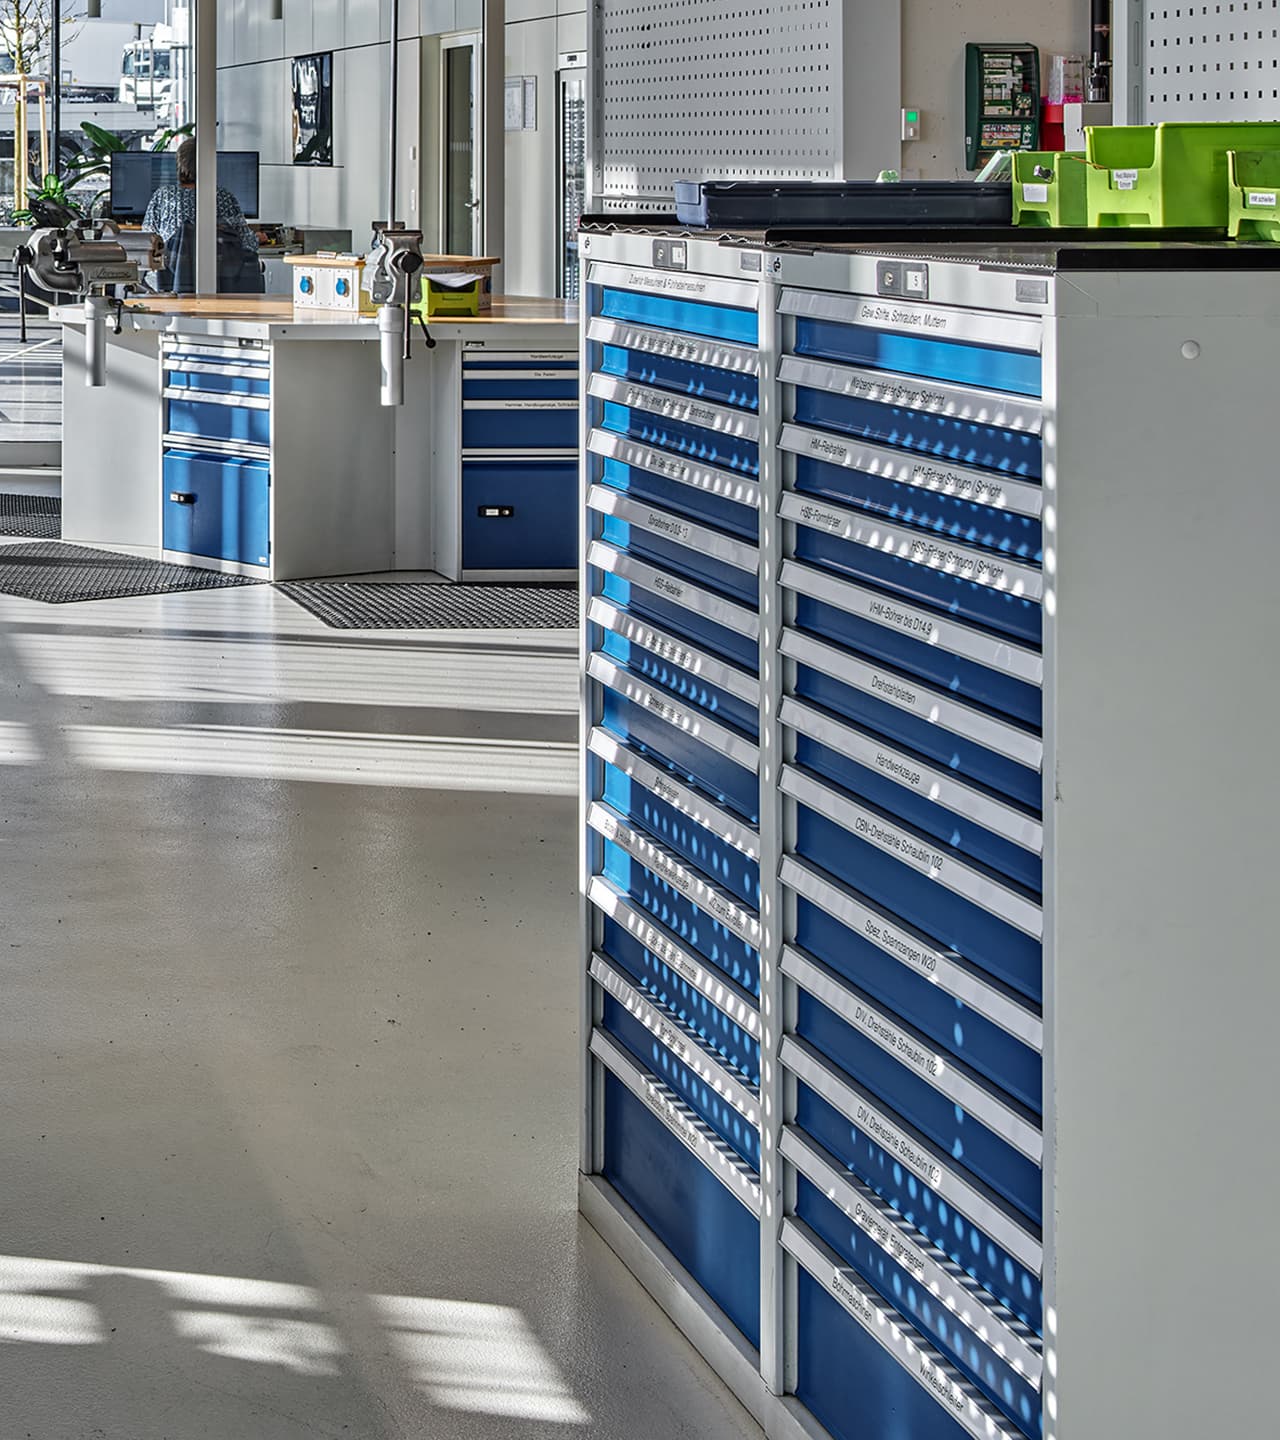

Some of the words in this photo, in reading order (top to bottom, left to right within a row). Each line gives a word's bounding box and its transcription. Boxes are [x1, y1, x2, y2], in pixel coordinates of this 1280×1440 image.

[945, 472, 972, 491] Schrupp
[975, 480, 1002, 497] Schlicht
[911, 539, 946, 561] HSS-Fräser
[947, 551, 973, 570] Schrupp
[977, 560, 1004, 579] Schlicht
[869, 601, 902, 626] VHM-Bohrer
[872, 675, 916, 705] Drehstahlplatten
[876, 753, 921, 785] Handwerkzeuge
[900, 842, 930, 864] Schaublin
[882, 929, 922, 967] Spannzangen
[896, 1033, 926, 1067] Schaublin
[898, 1139, 929, 1173] Schaublin
[831, 1276, 873, 1323] Bohrmaschinen
[919, 1358, 964, 1412] Winkelschleifer
